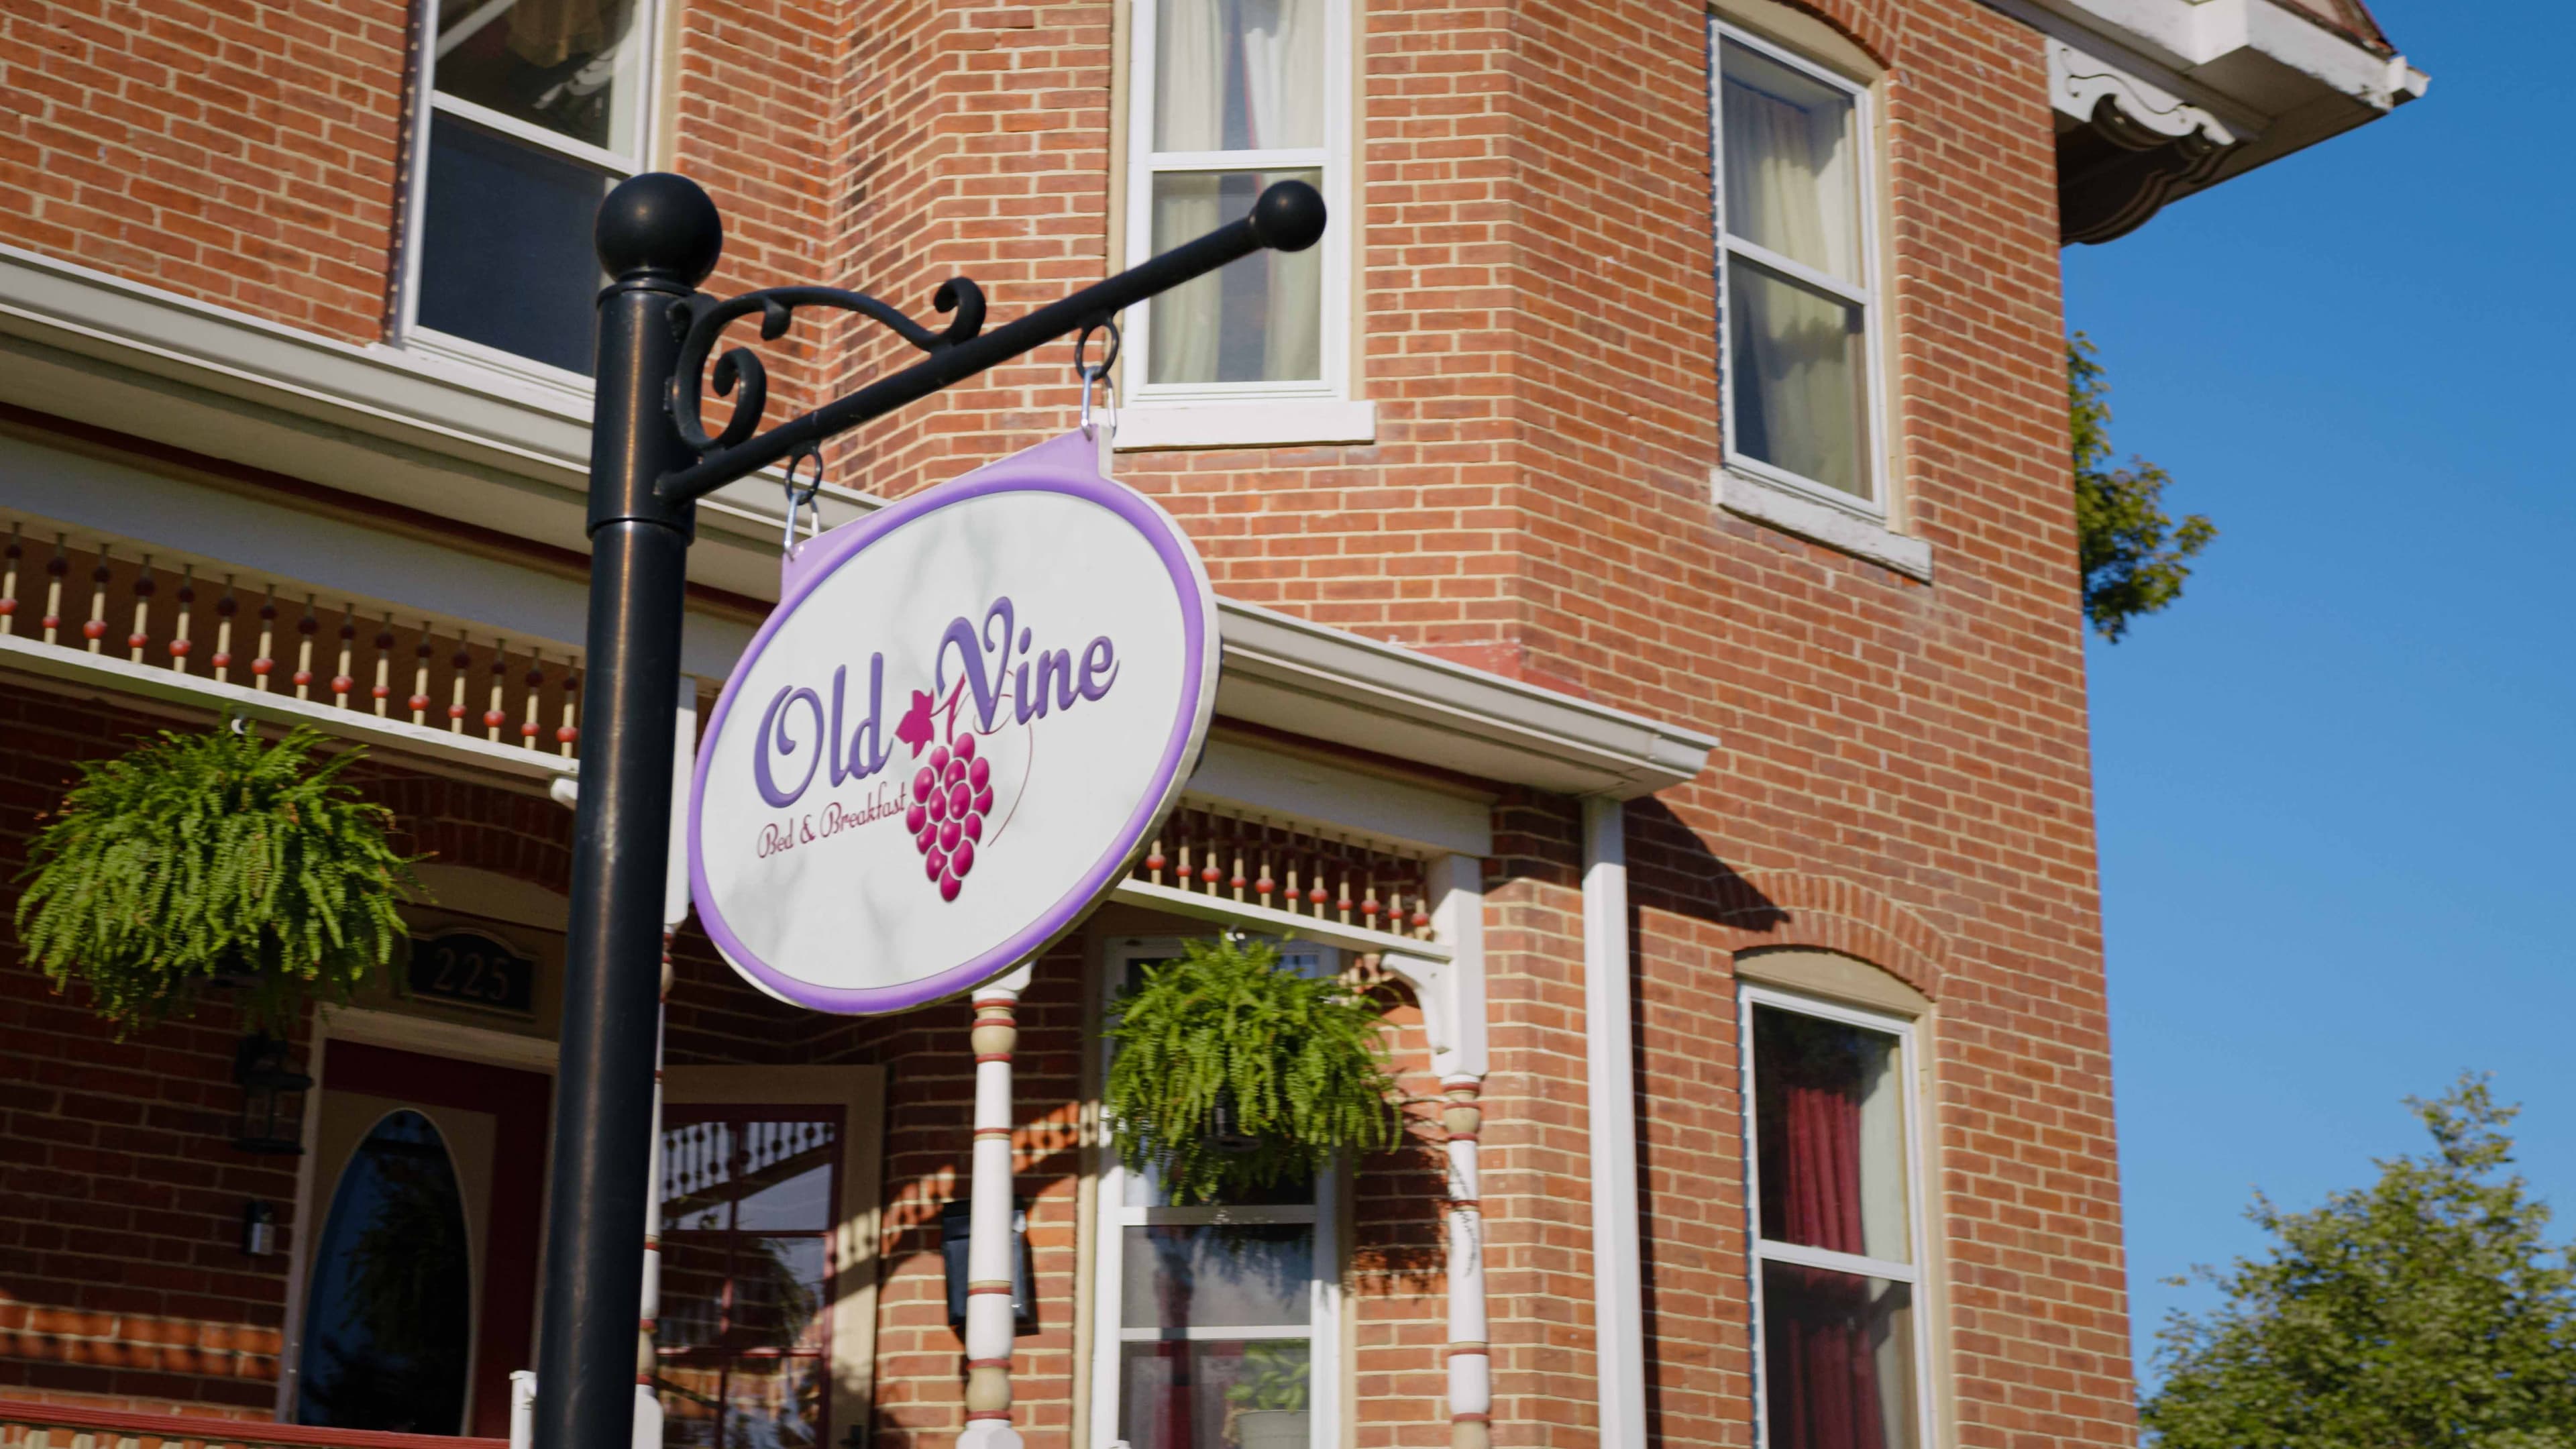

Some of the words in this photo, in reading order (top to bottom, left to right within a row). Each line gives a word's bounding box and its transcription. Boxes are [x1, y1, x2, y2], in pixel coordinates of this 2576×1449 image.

[754, 652, 893, 808] Old
[936, 596, 1120, 733] Vine
[757, 818, 794, 858] Bed
[800, 814, 816, 844] &
[820, 782, 906, 838] Breakfast
[433, 947, 508, 1000] 225
